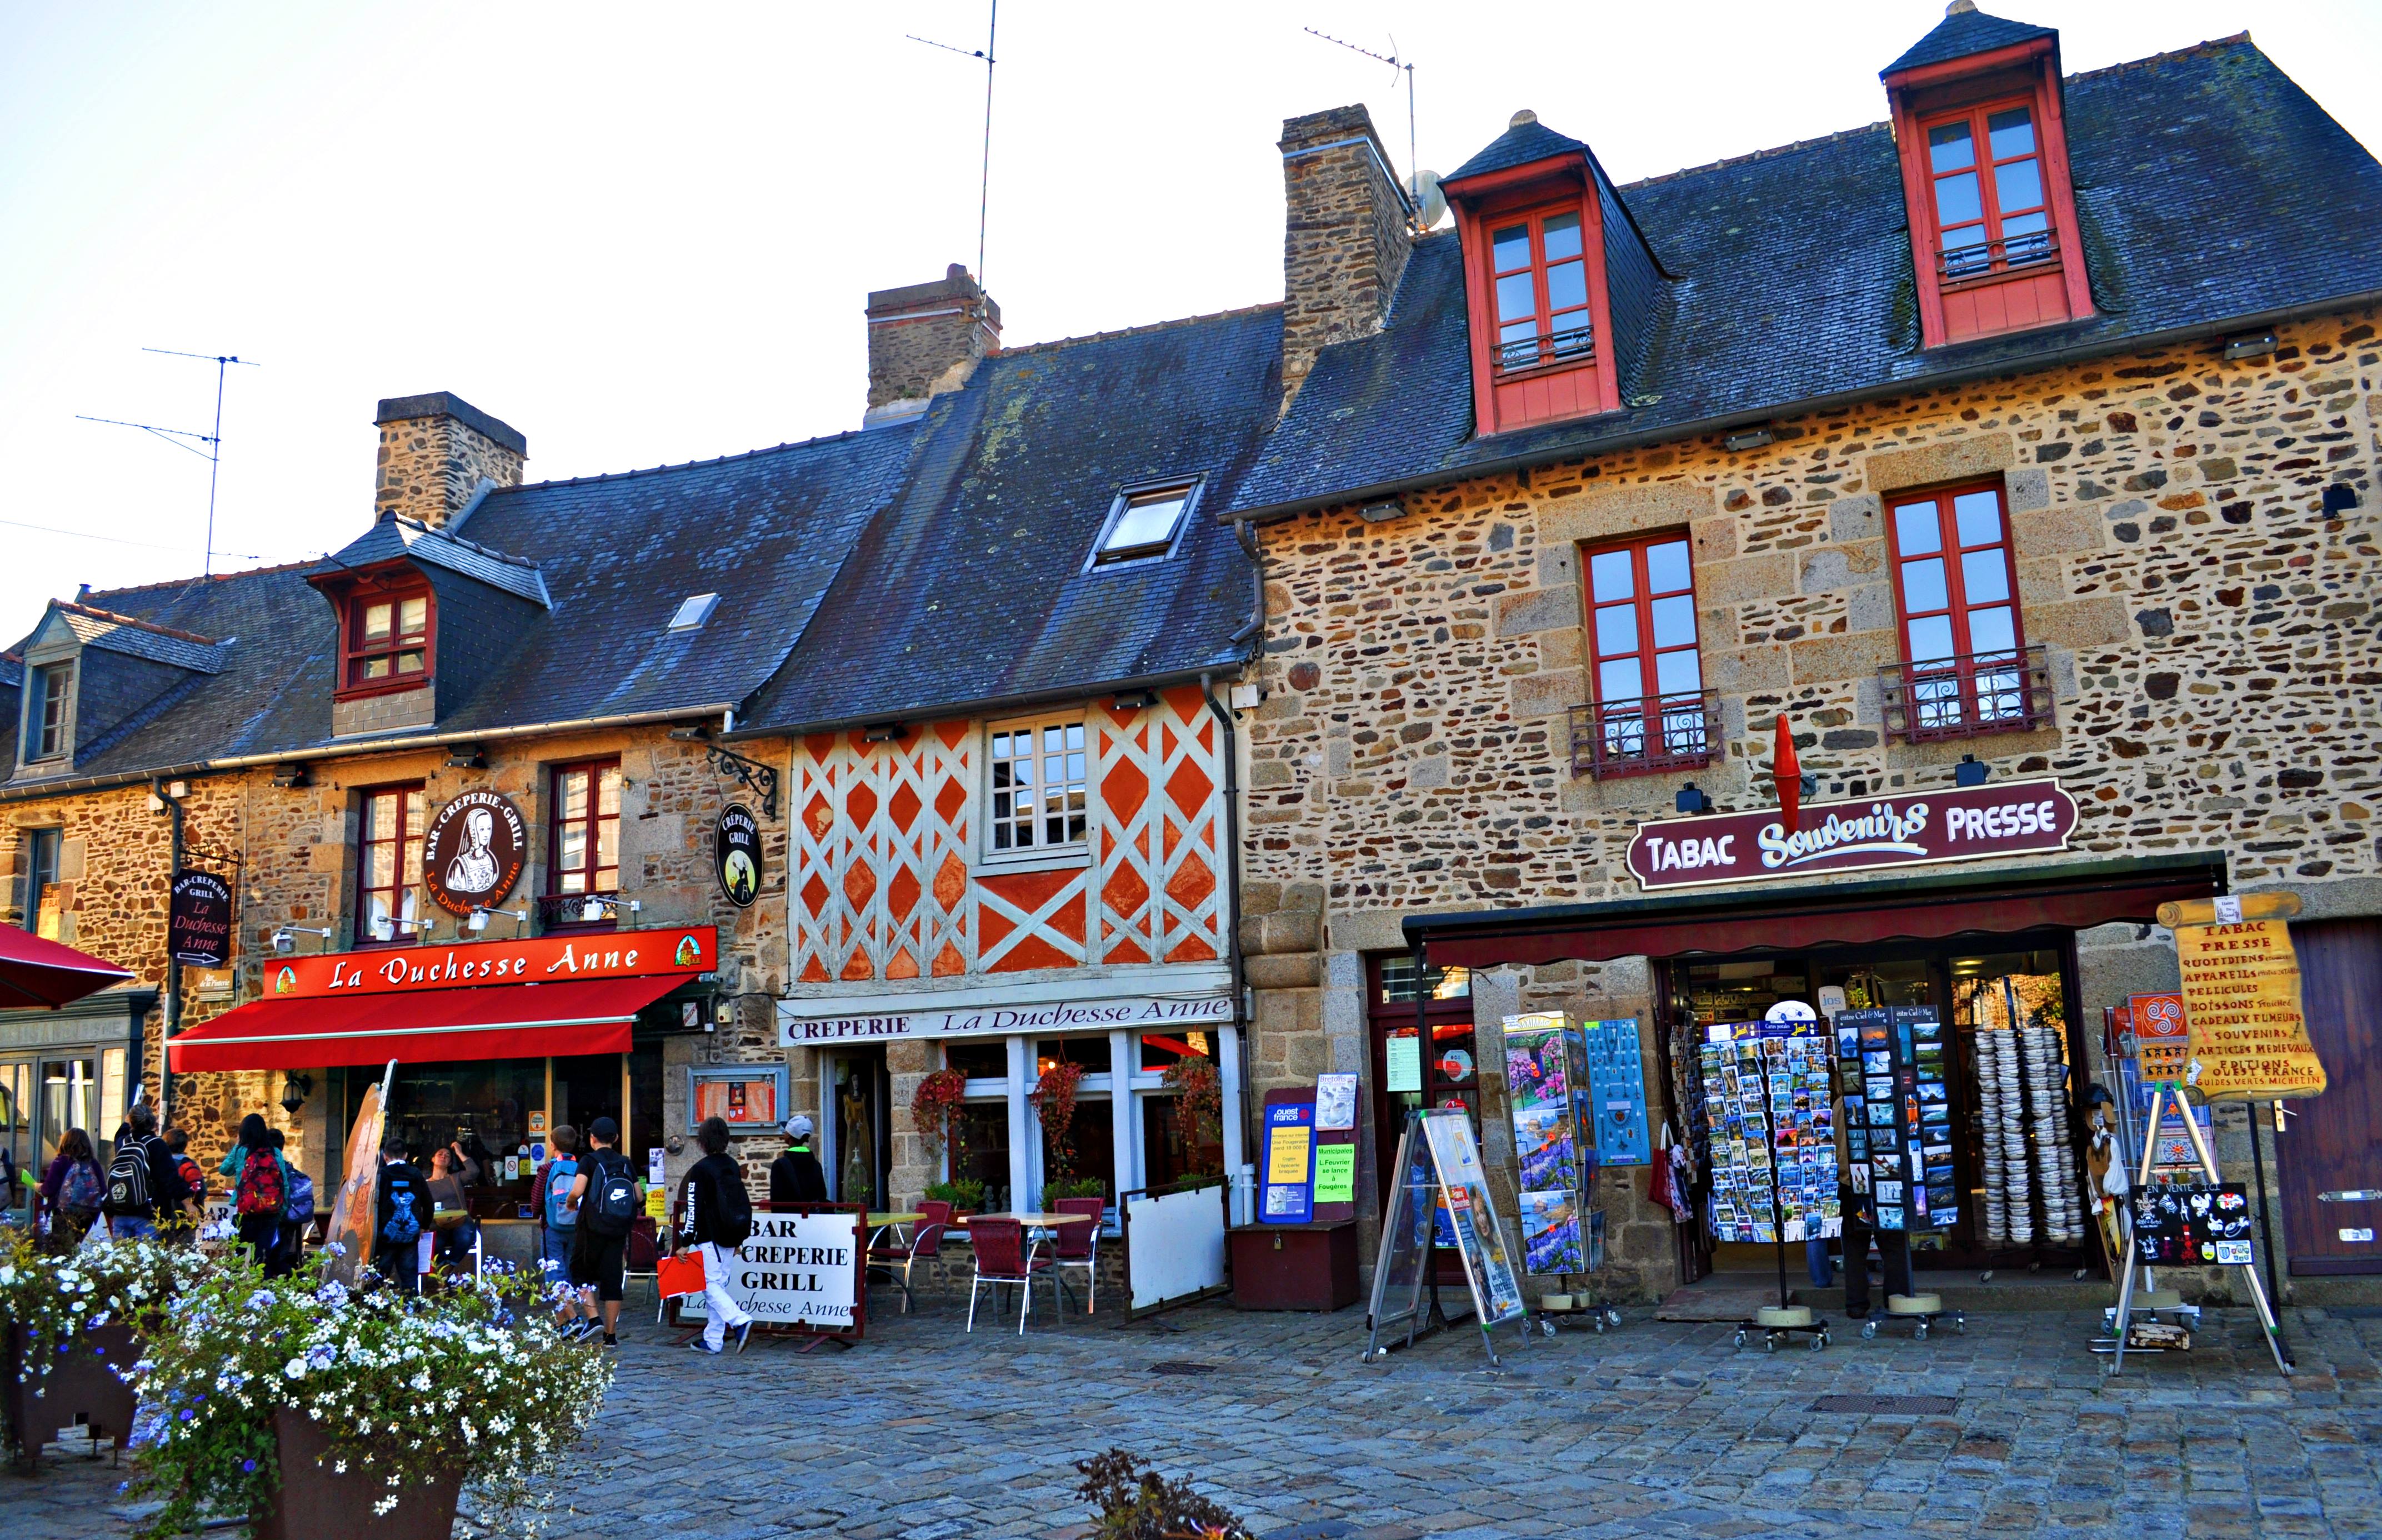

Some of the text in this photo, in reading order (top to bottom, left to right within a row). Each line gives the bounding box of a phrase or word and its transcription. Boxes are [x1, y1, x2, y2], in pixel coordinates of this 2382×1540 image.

[426, 793, 523, 861] BAR CREPERIE GRILL
[722, 812, 755, 834] CRÊPERIE
[729, 832, 749, 846] GRILL
[1645, 800, 2057, 872] TABAC Souvenirs PRESSE
[189, 889, 214, 899] GRILL
[427, 862, 519, 913] La Duchee Anne
[193, 902, 209, 915] La
[174, 916, 227, 934] Duchesse
[2204, 922, 2266, 936] TABAC
[183, 936, 218, 951] Anne
[2200, 938, 2271, 952] PRESSE
[329, 943, 638, 989] La Duchesse Anne
[2183, 954, 2264, 968] QUOTIDIENS
[2184, 969, 2257, 983] APPAREILS
[2188, 984, 2258, 996] PELLICULES
[1908, 1008, 1918, 1017] Ciel
[2190, 999, 2254, 1012] BOISSONS
[788, 998, 1228, 1041] CREPERIE La Duchesse Anne
[1855, 1011, 1867, 1020] Ciel
[1874, 1010, 1886, 1018] Mer
[2191, 1013, 2301, 1026] CADEAUX FUMEURS
[2214, 1029, 2288, 1040] SOUVENIRS
[2196, 1043, 2315, 1056] ARTICLES MEDIEVAUX
[2220, 1059, 2289, 1069] EDITIONS
[2213, 1067, 2314, 1077] OUEST FRANCE
[2269, 1076, 2320, 1084] MICHELIN
[688, 1182, 695, 1192] US
[2167, 1184, 2194, 1193] VENTE
[2201, 1183, 2221, 1192] ICI
[208, 1207, 229, 1221] AR
[750, 1220, 798, 1238] BAR
[741, 1246, 849, 1266] CREPERIE
[741, 1272, 823, 1292] GRILL
[685, 1292, 849, 1317] La uchesse Anne
